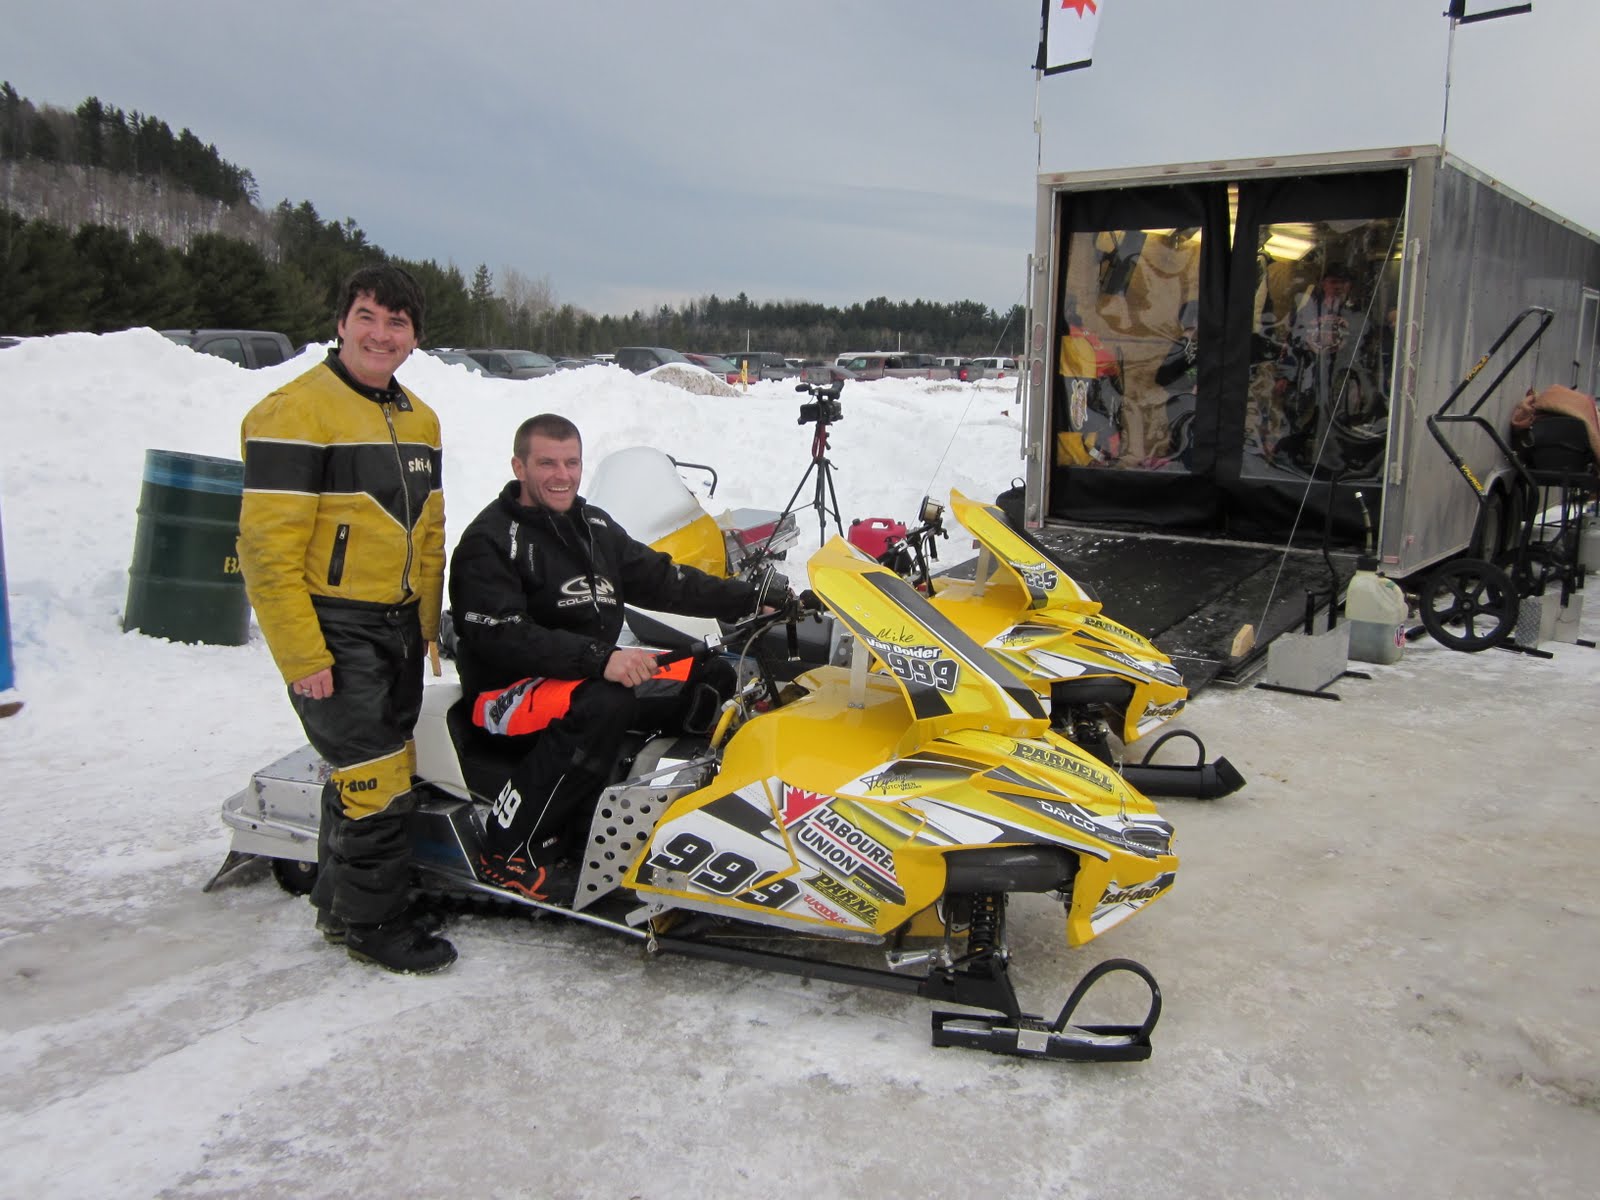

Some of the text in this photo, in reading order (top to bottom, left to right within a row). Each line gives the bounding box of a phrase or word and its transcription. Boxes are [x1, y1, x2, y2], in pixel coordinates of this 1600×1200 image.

[866, 637, 941, 659] Van Dolder
[876, 625, 916, 643] Mike
[888, 652, 959, 693] 999
[1015, 743, 1115, 791] PARNELL
[1038, 800, 1098, 832] DAYCO
[801, 827, 858, 872] UNION
[646, 832, 802, 911] 999
